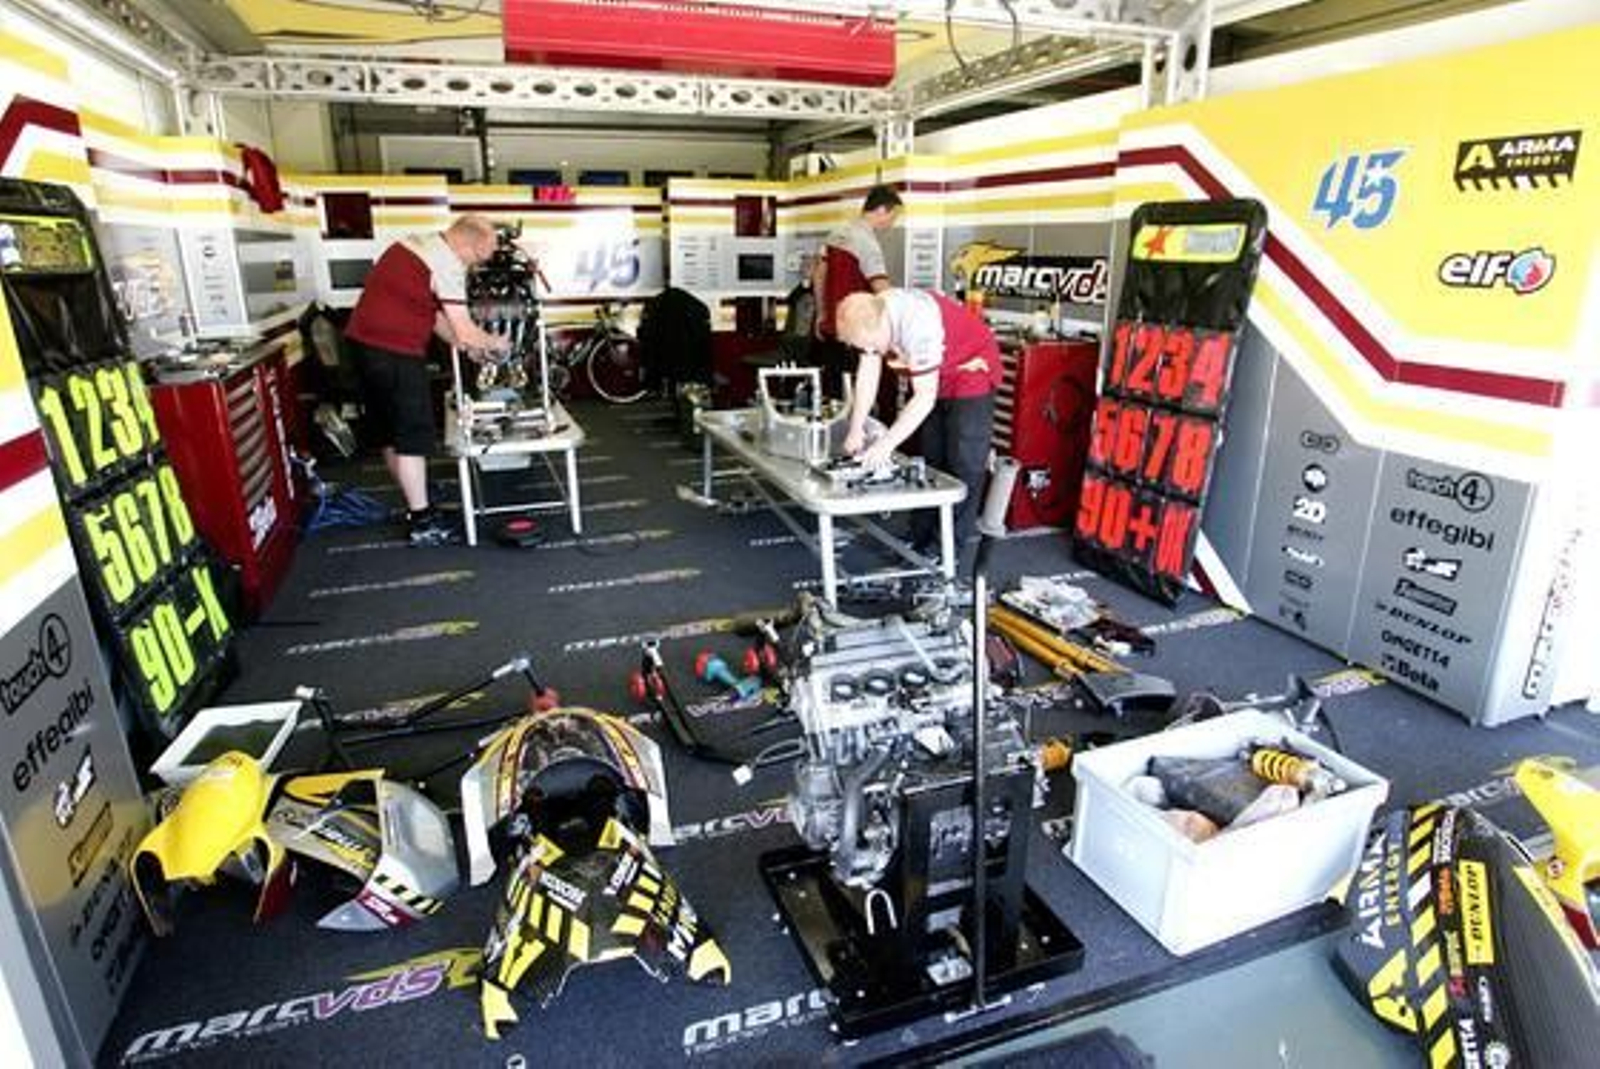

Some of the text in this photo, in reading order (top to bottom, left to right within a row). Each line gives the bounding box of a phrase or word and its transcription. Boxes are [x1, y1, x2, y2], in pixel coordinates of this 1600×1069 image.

[1499, 136, 1576, 156] ARMA
[1311, 150, 1405, 230] 45
[1091, 404, 1213, 493] 5678
[84, 466, 195, 604] 5678
[1390, 507, 1495, 551] effegibi
